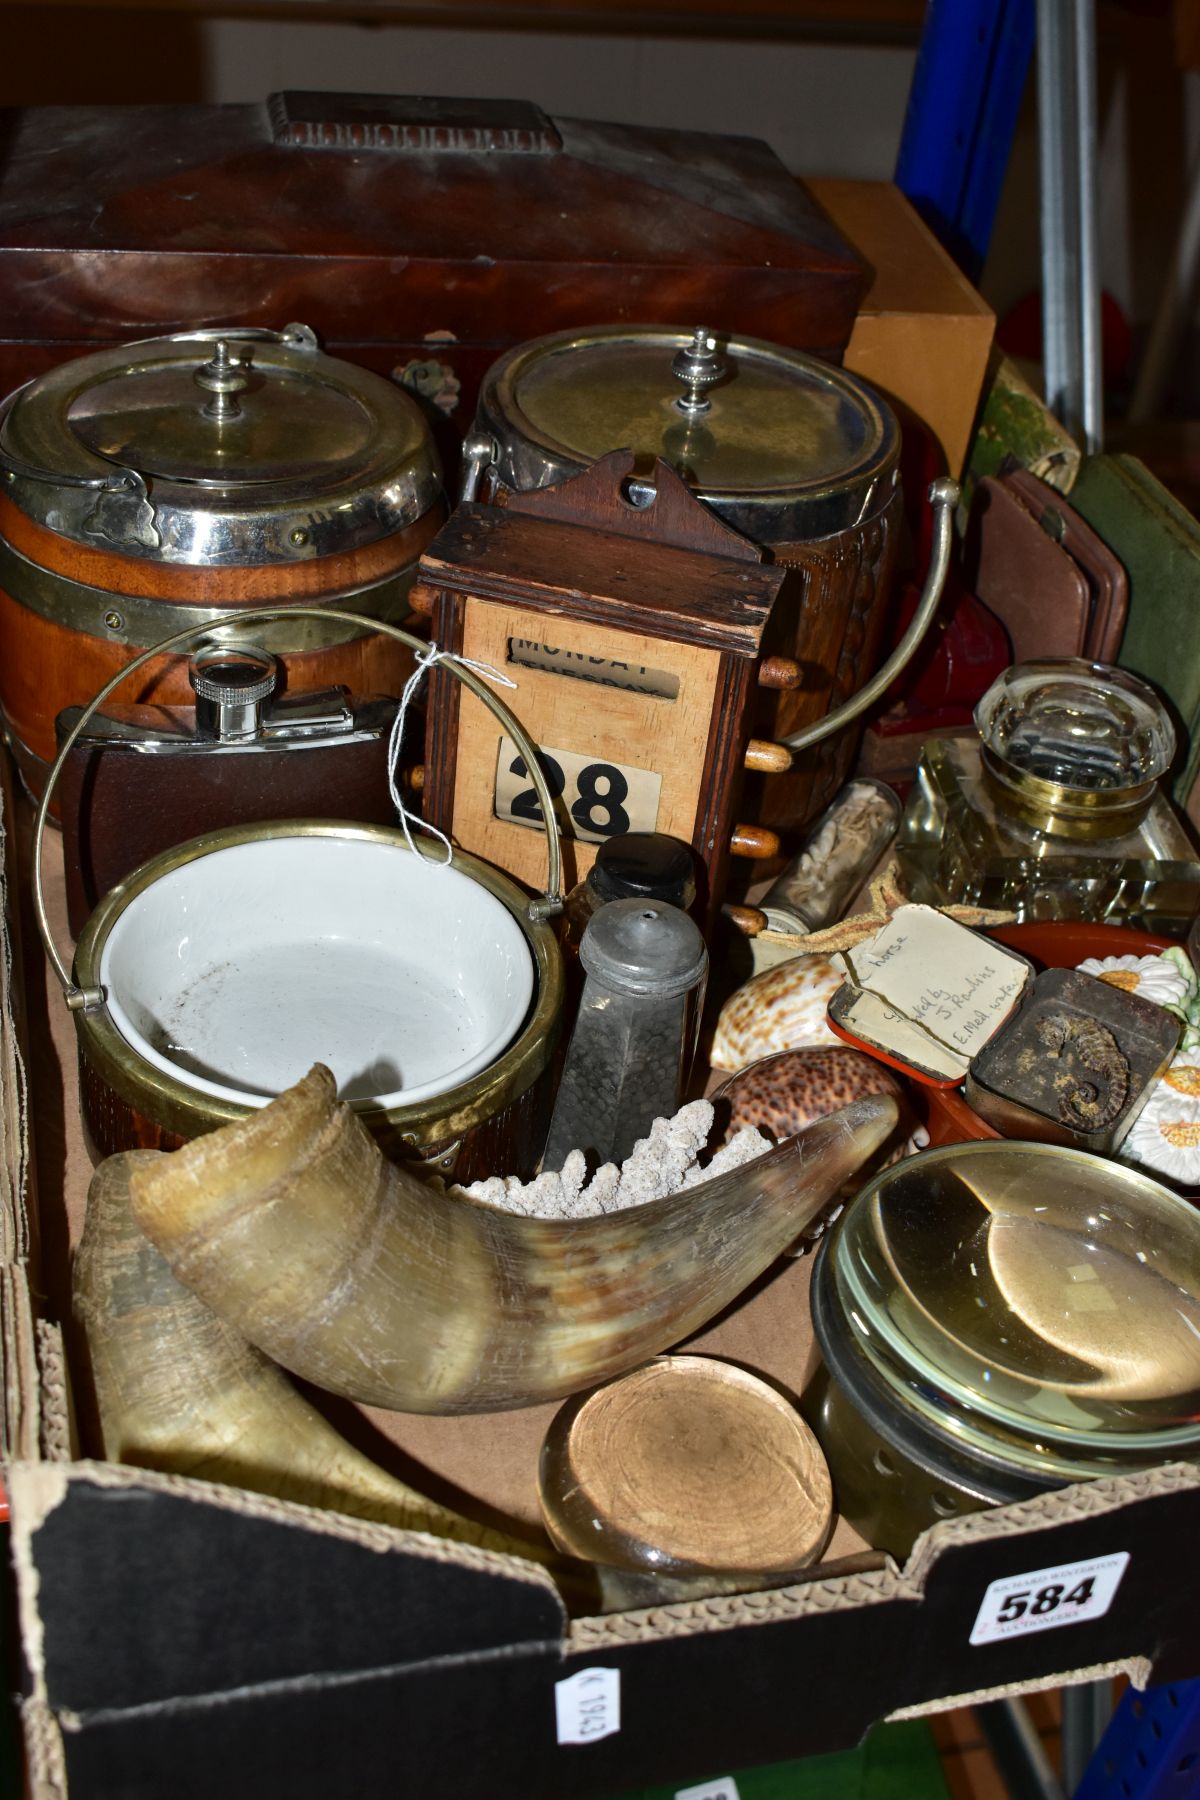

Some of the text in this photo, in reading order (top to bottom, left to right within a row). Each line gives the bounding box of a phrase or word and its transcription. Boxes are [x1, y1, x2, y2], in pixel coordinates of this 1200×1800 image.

[509, 751, 630, 836] 28
[868, 936, 908, 967] horse
[997, 1576, 1096, 1623] 584
